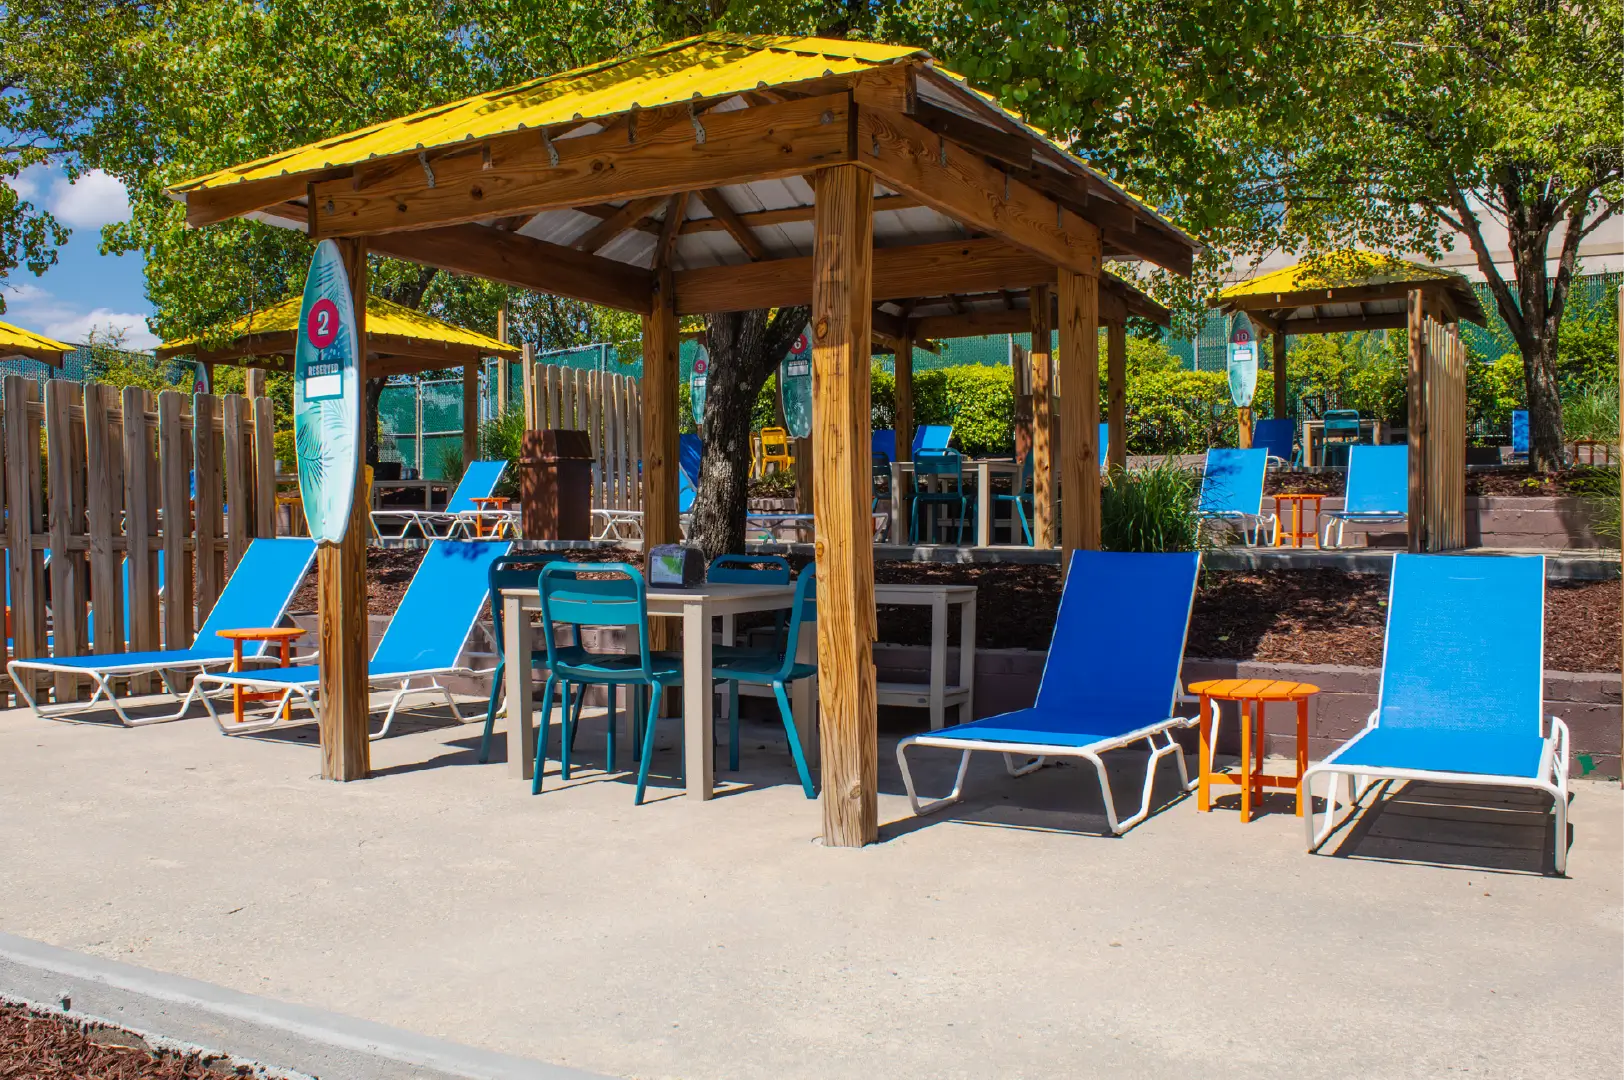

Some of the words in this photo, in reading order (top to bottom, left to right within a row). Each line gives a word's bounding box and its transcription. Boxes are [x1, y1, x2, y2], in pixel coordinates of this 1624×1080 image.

[317, 310, 329, 336] 2
[794, 337, 802, 350] 6
[1236, 333, 1248, 341] 10
[308, 363, 339, 377] RESERVED
[697, 363, 704, 371] 9
